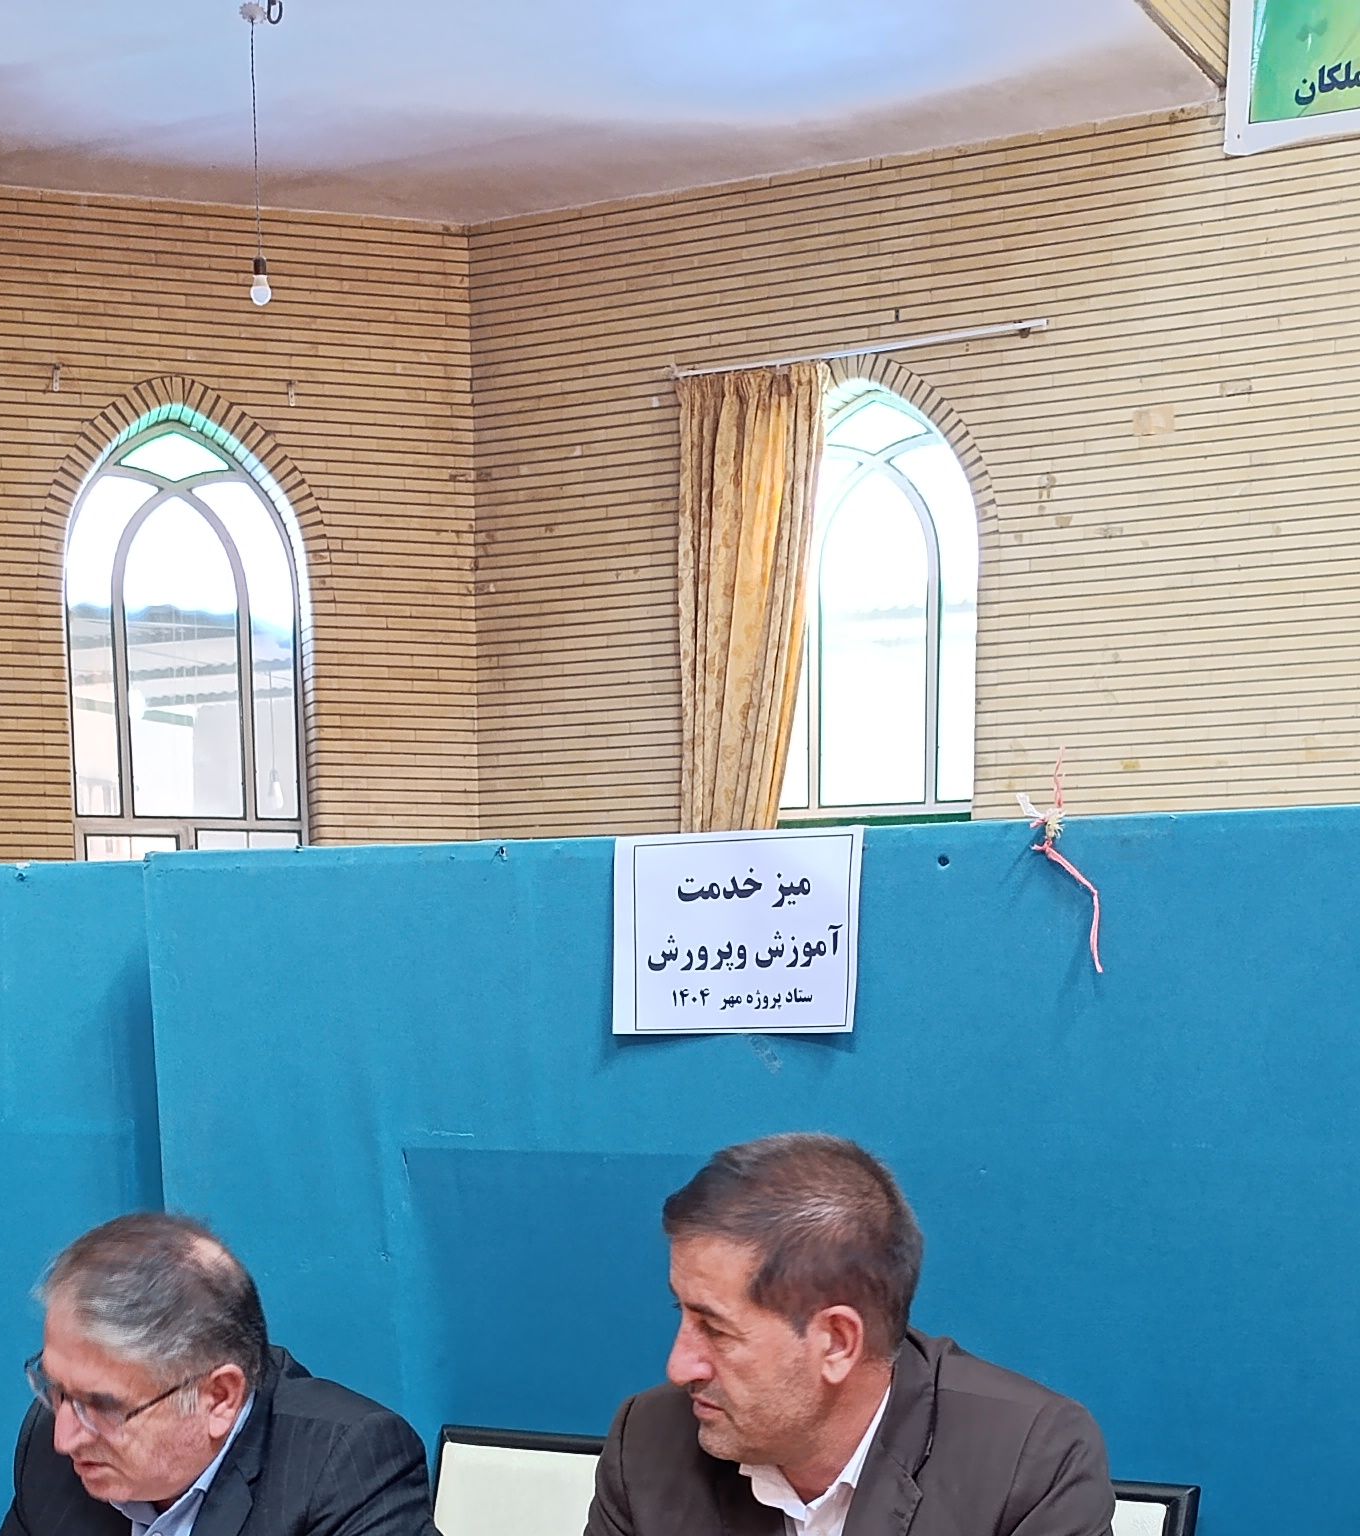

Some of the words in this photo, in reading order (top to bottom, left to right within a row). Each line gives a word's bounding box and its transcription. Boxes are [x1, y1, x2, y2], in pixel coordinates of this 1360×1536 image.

[678, 868, 762, 901] خدمت
[772, 873, 810, 907] میز
[755, 924, 842, 968] آموزش
[673, 988, 709, 1006] ۱۴۰۴
[720, 996, 742, 1010] مهر
[747, 990, 781, 1009] پروژه
[786, 988, 812, 1003] ستاد
